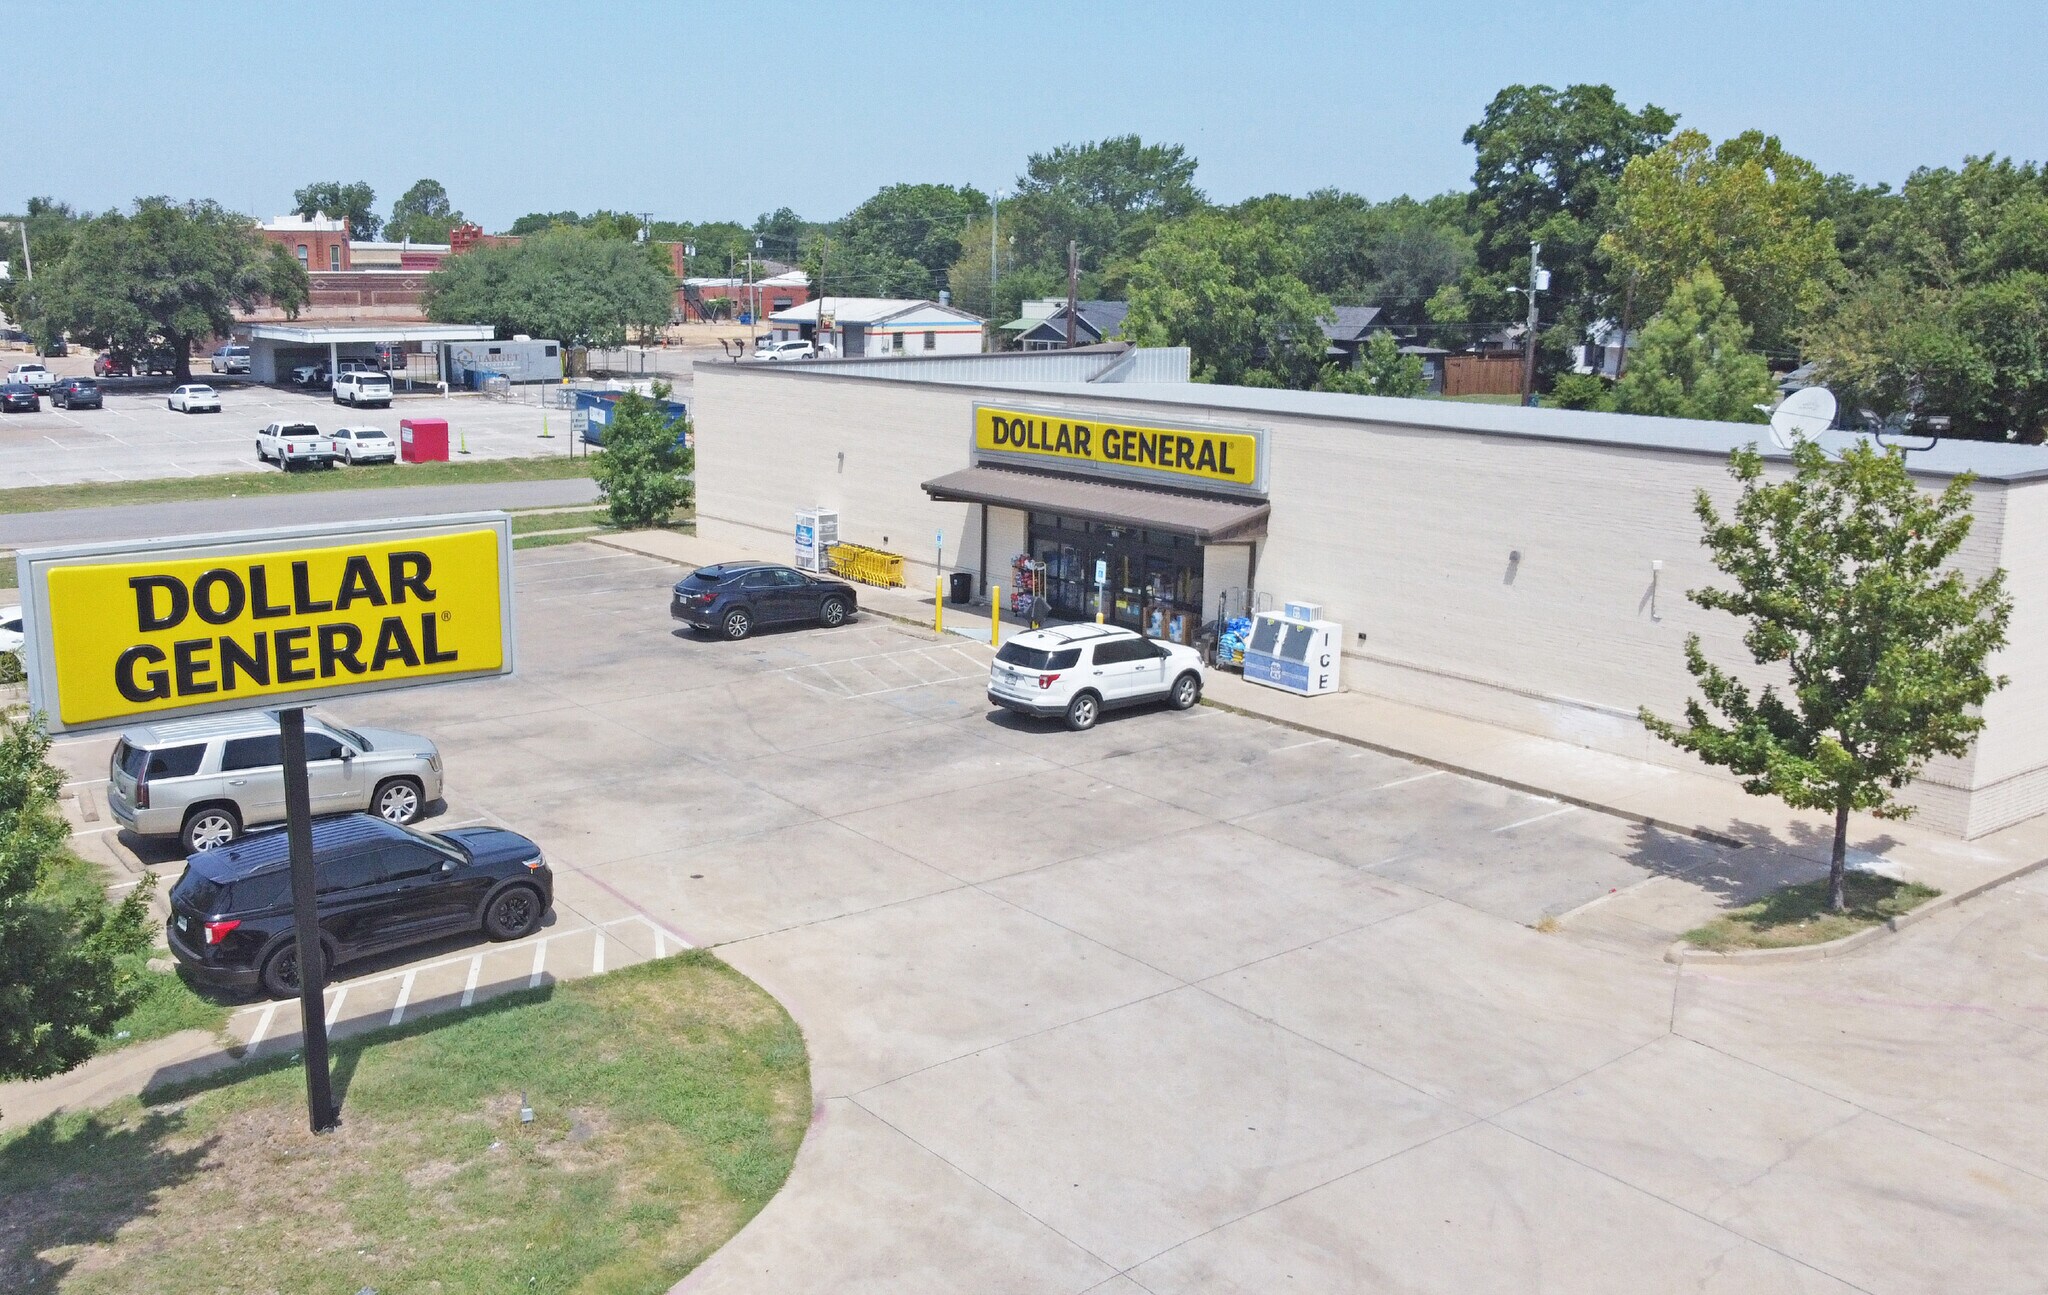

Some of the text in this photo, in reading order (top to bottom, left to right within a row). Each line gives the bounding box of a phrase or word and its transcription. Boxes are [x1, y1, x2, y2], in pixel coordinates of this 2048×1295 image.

[477, 353, 520, 362] TARGET
[991, 415, 1235, 475] DOLLAR GENERAL
[128, 550, 437, 633] DOLLAR
[114, 612, 458, 703] GENERAL
[1319, 633, 1330, 689] ICE
